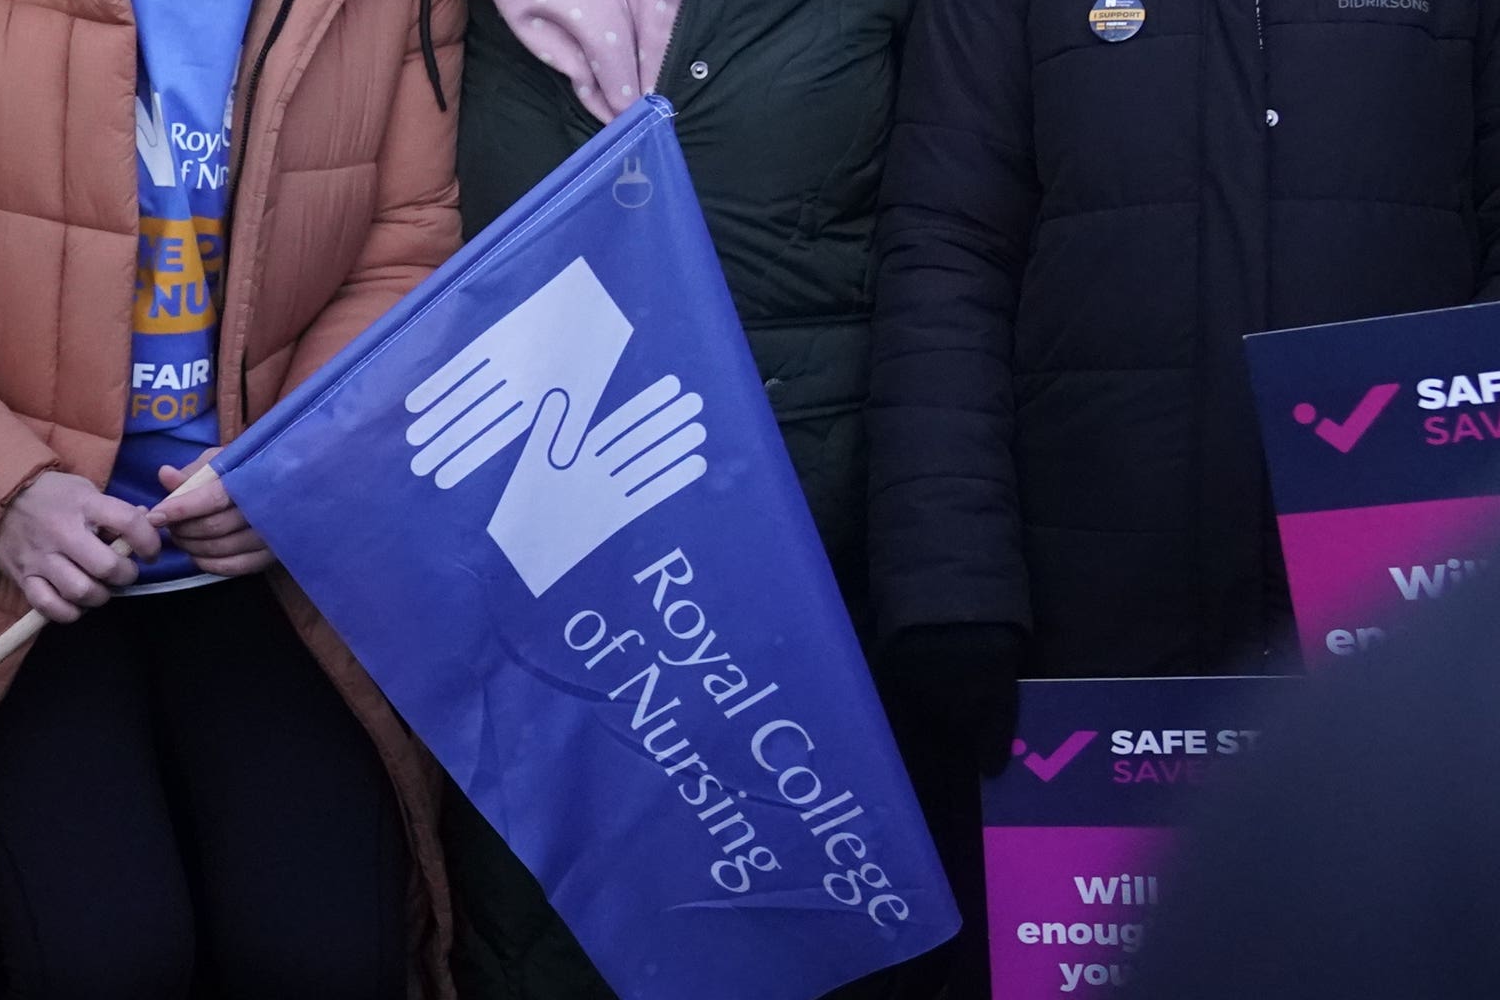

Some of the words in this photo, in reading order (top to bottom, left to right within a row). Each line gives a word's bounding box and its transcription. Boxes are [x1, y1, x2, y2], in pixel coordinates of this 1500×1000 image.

[1098, 11, 1142, 19] SUPPORT
[171, 122, 221, 162] Roy
[132, 358, 209, 391] FAIR
[1416, 370, 1500, 410] SAF
[131, 392, 199, 422] FOR
[1423, 411, 1500, 446] SAV
[563, 609, 647, 671] of
[608, 663, 783, 895] Nursing
[632, 545, 780, 721] Royal
[752, 717, 911, 929] College
[1110, 729, 1208, 755] SAFE
[1073, 873, 1159, 905] Will
[1016, 921, 1147, 953] enoug
